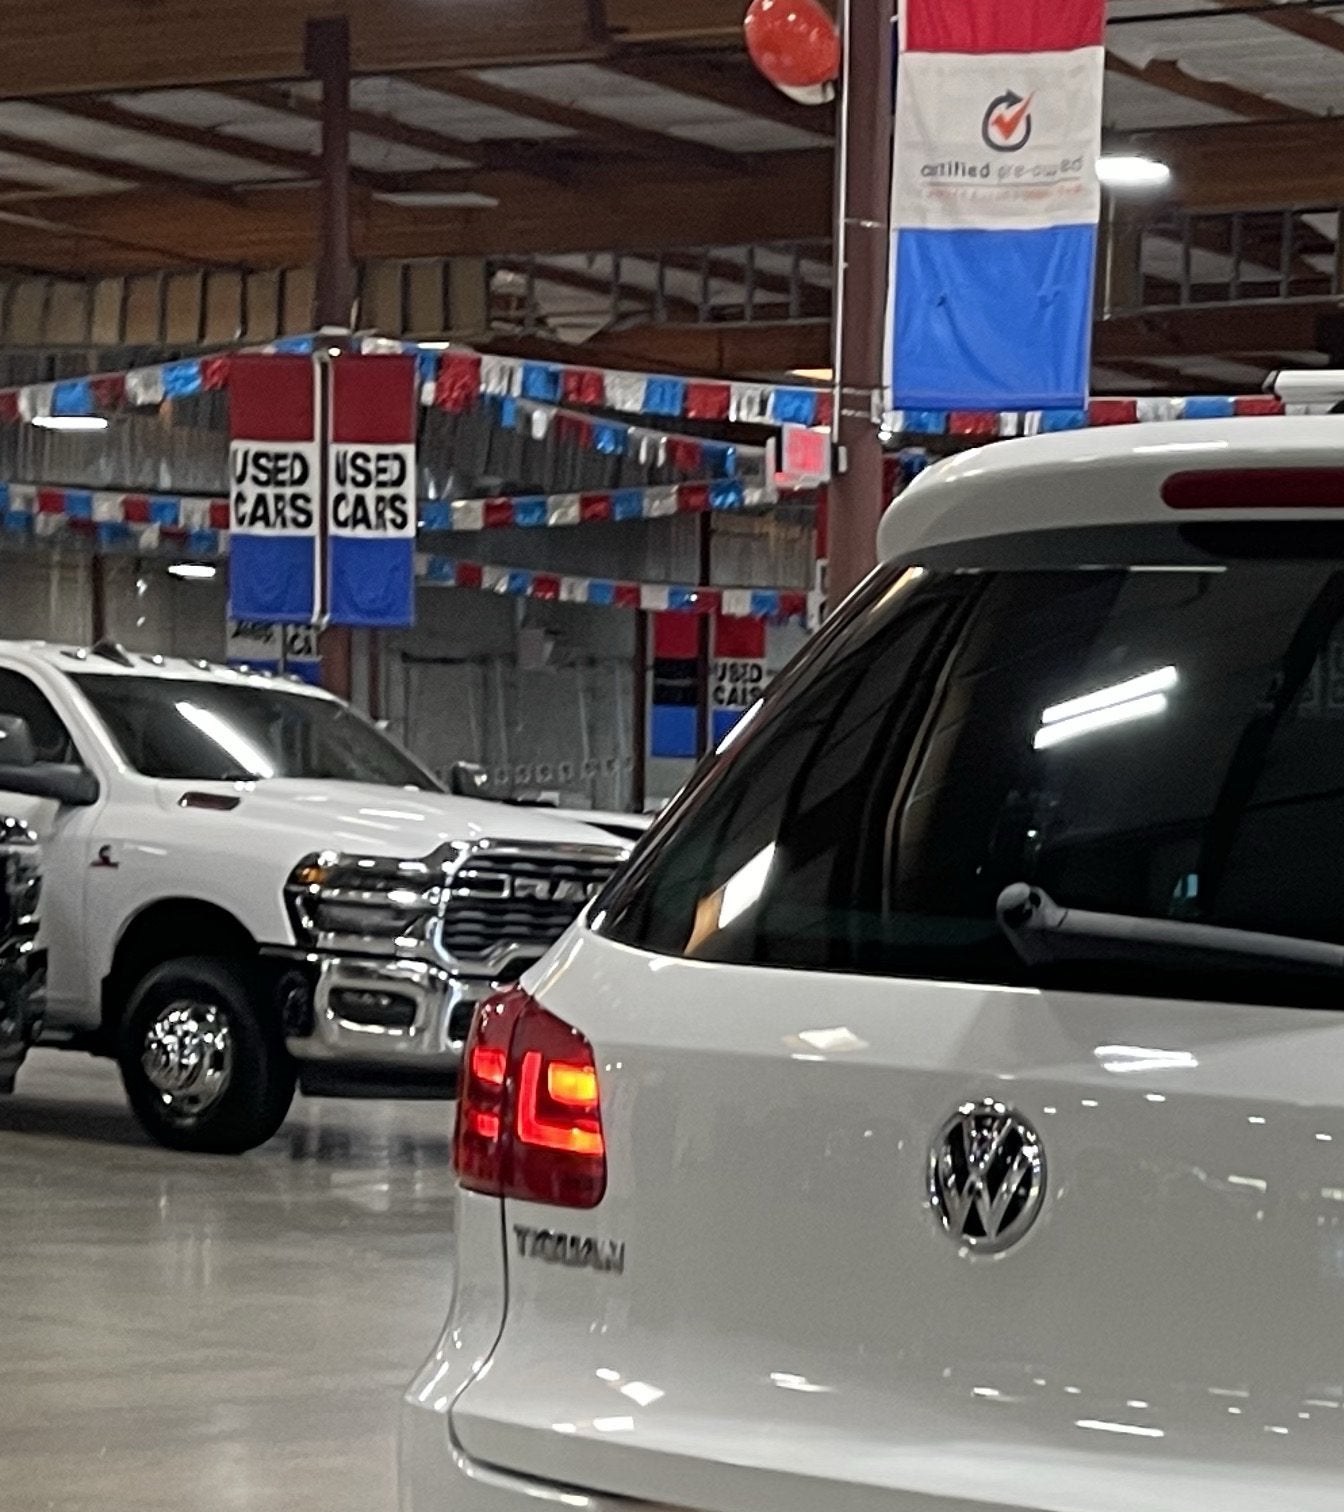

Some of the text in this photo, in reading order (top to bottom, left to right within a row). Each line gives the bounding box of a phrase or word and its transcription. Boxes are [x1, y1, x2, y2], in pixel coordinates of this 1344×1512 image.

[235, 449, 310, 487] USED
[336, 450, 407, 488] USED
[234, 491, 313, 529] CARS
[333, 492, 408, 531] CARS
